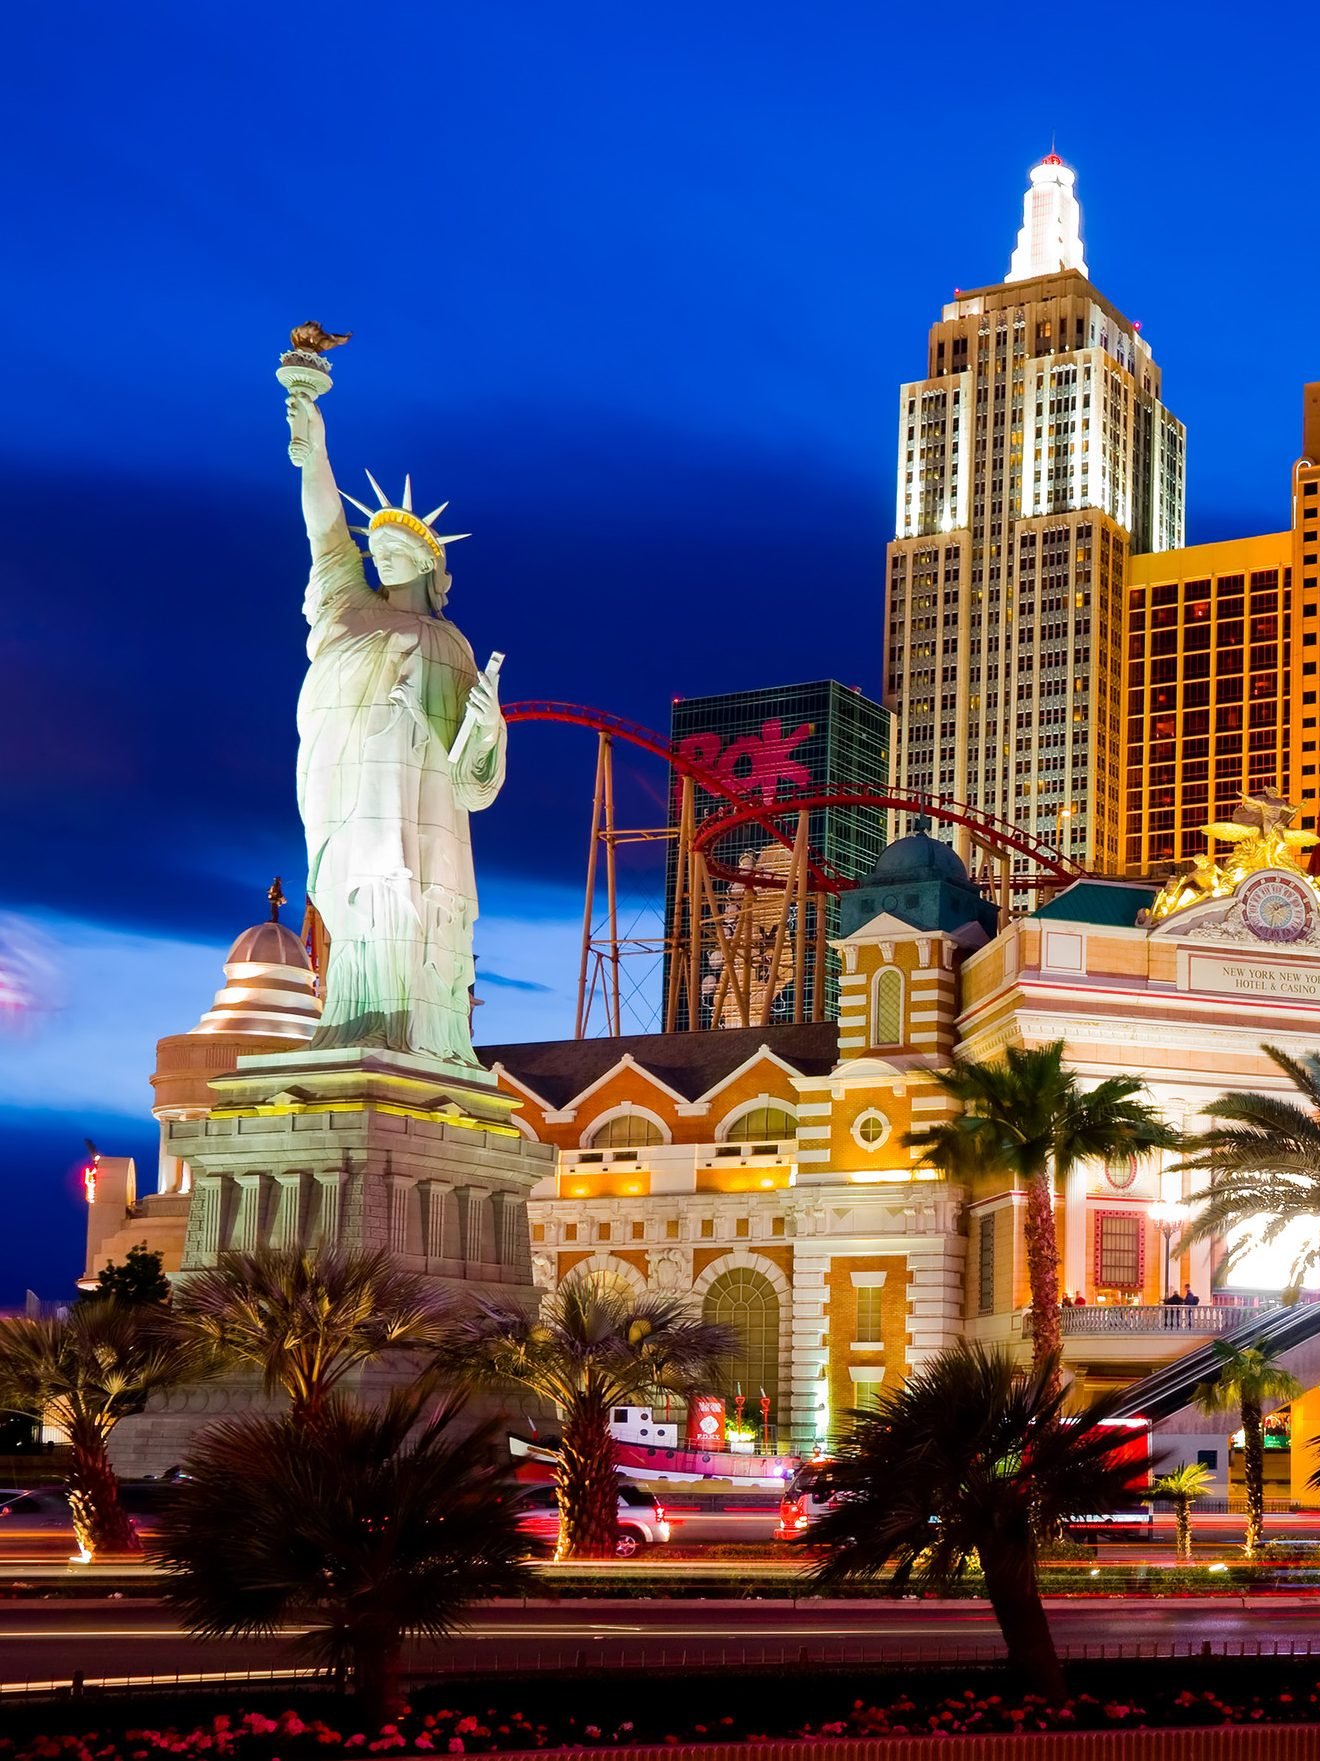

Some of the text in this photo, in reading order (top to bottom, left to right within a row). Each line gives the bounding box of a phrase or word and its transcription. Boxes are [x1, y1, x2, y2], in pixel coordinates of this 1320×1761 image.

[1223, 967, 1245, 977] NEW
[1249, 969, 1275, 980] YORK
[1280, 972, 1301, 981] NEW
[1235, 979, 1316, 994] HOTEL & CASINO
